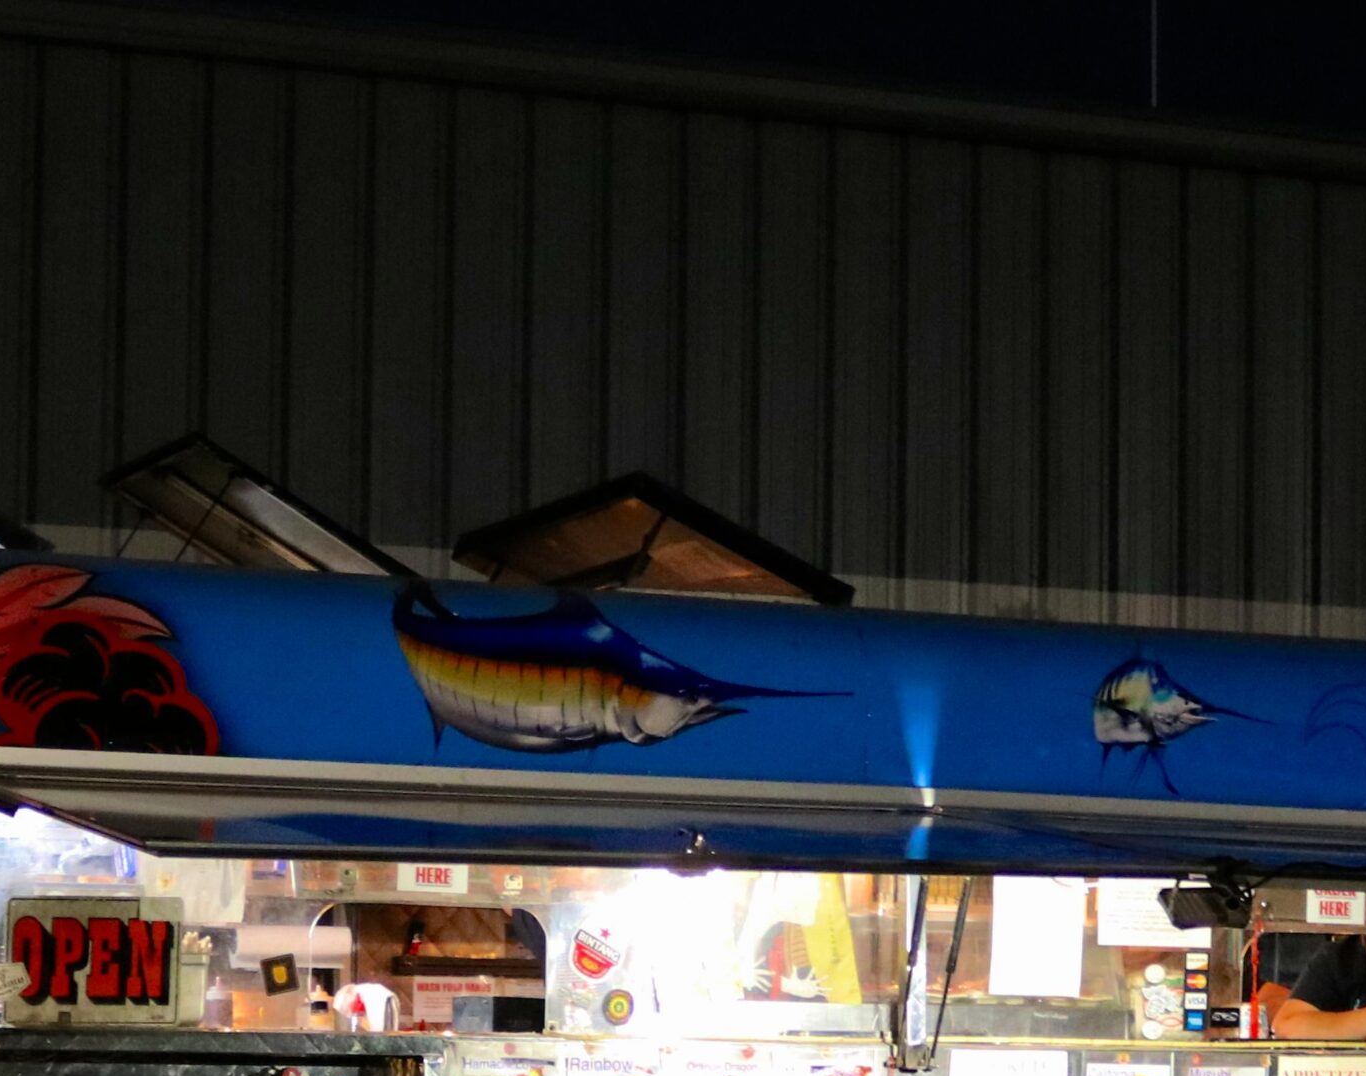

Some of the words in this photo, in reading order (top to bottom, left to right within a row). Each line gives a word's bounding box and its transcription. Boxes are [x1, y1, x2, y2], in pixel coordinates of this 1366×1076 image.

[415, 867, 453, 885] HERE
[1319, 901, 1351, 917] HERE
[577, 931, 620, 961] BINTANG
[12, 915, 175, 1006] OPEN
[570, 1058, 634, 1073] Rainbow
